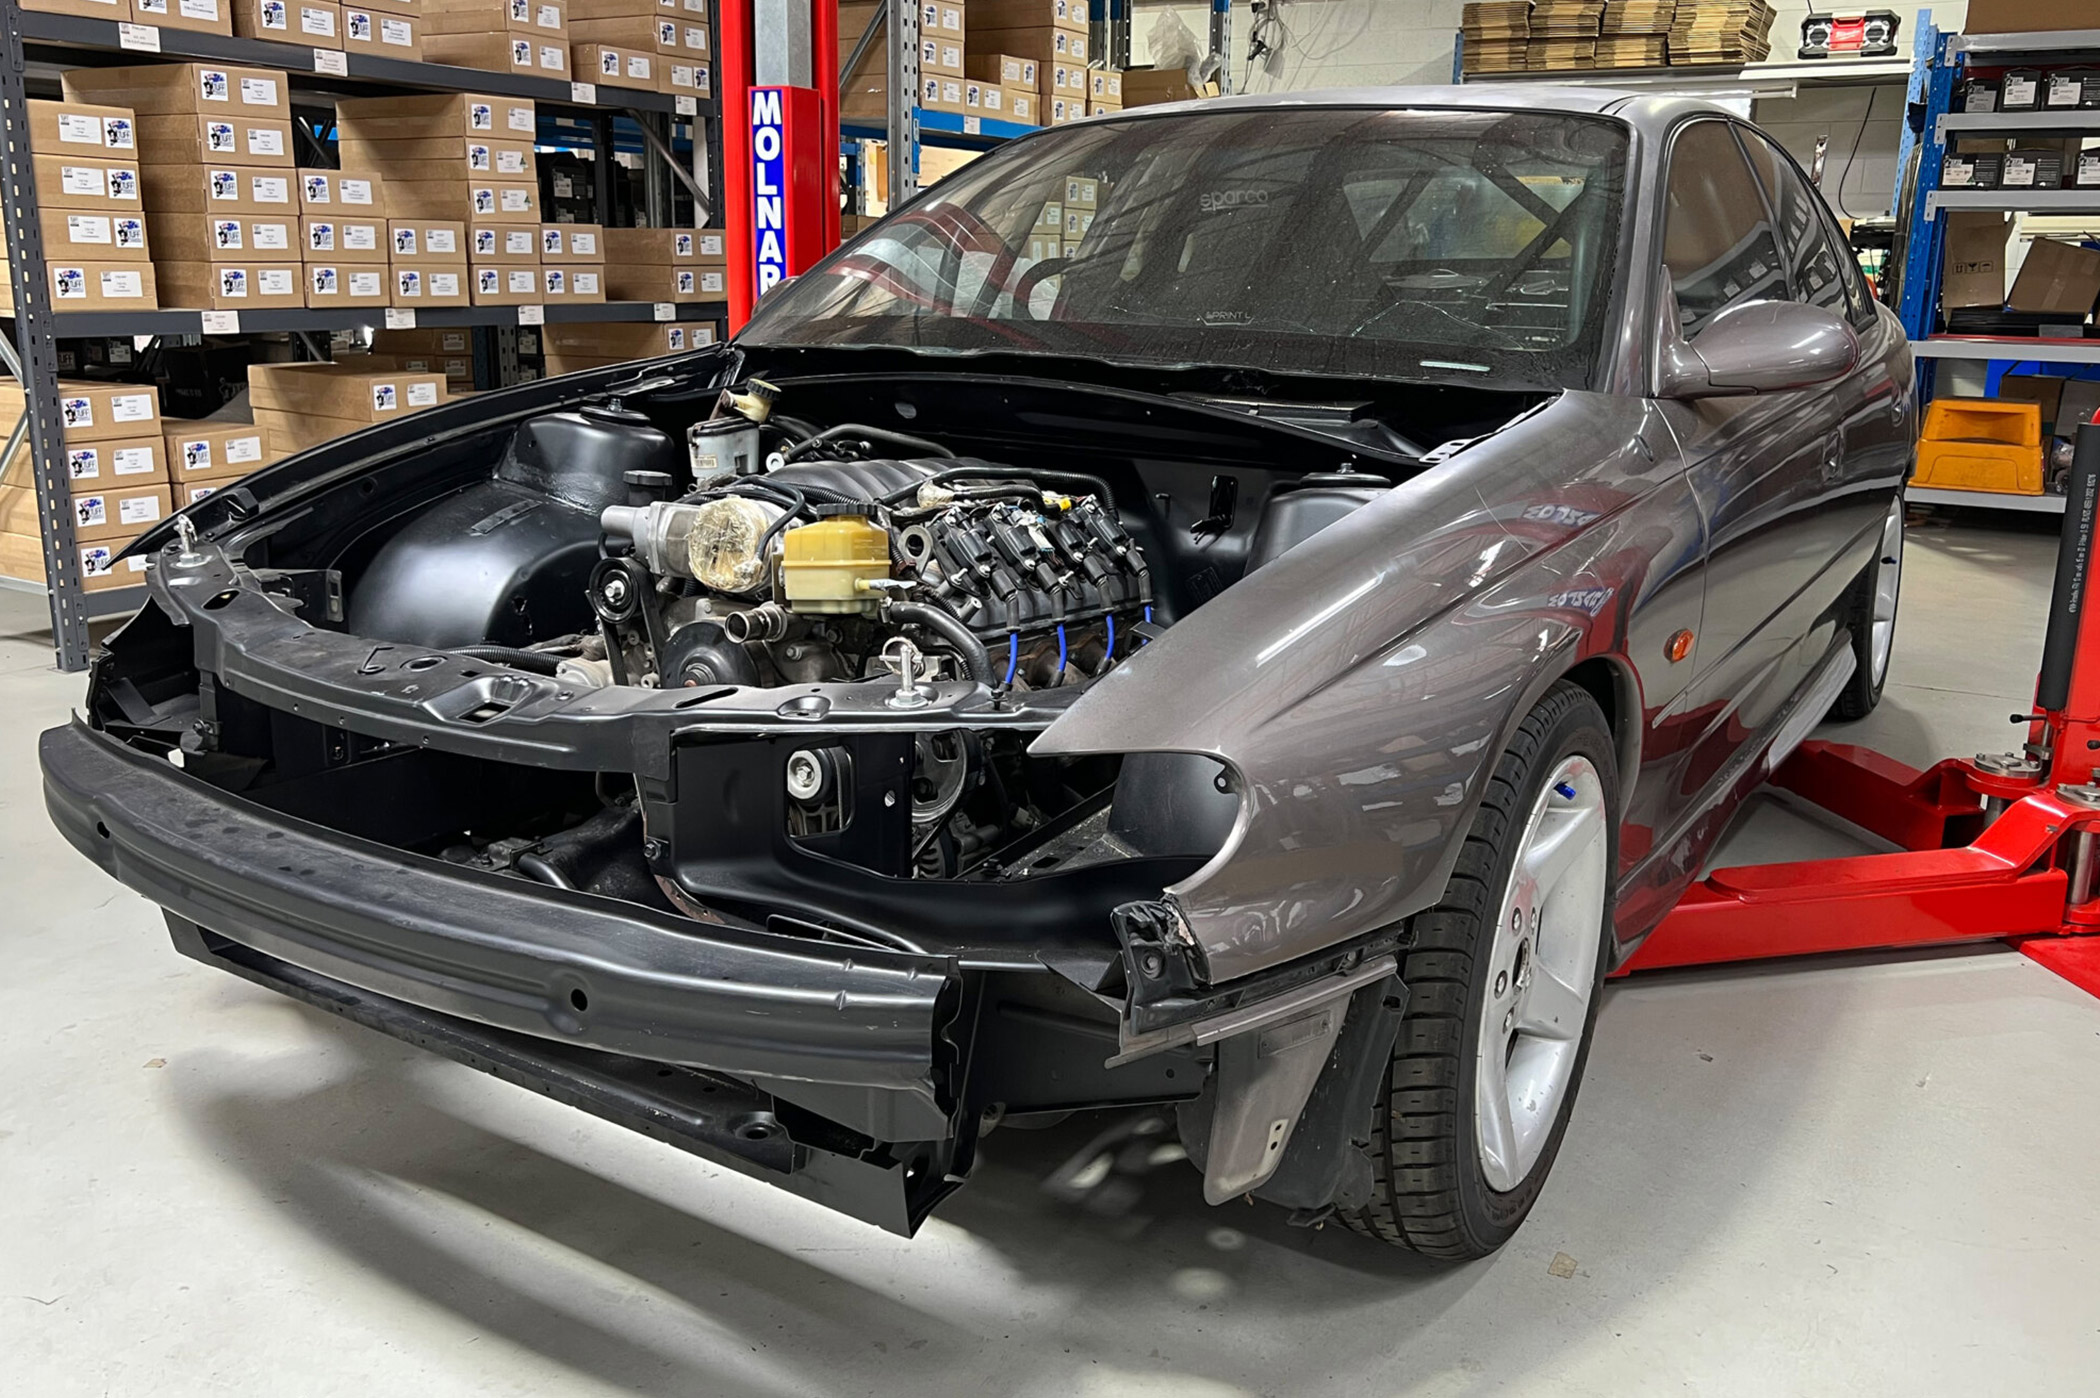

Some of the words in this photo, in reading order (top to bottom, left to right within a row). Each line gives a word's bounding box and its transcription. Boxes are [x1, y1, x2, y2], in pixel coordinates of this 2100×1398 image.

[118, 131, 131, 139] TUFF
[122, 182, 135, 190] TUFF
[1200, 190, 1268, 211] sparco
[128, 230, 140, 238] TUFF
[70, 280, 82, 288] TUFF
[76, 409, 89, 417] TUFF
[83, 461, 96, 469] TUFF
[90, 508, 103, 516] TUFF
